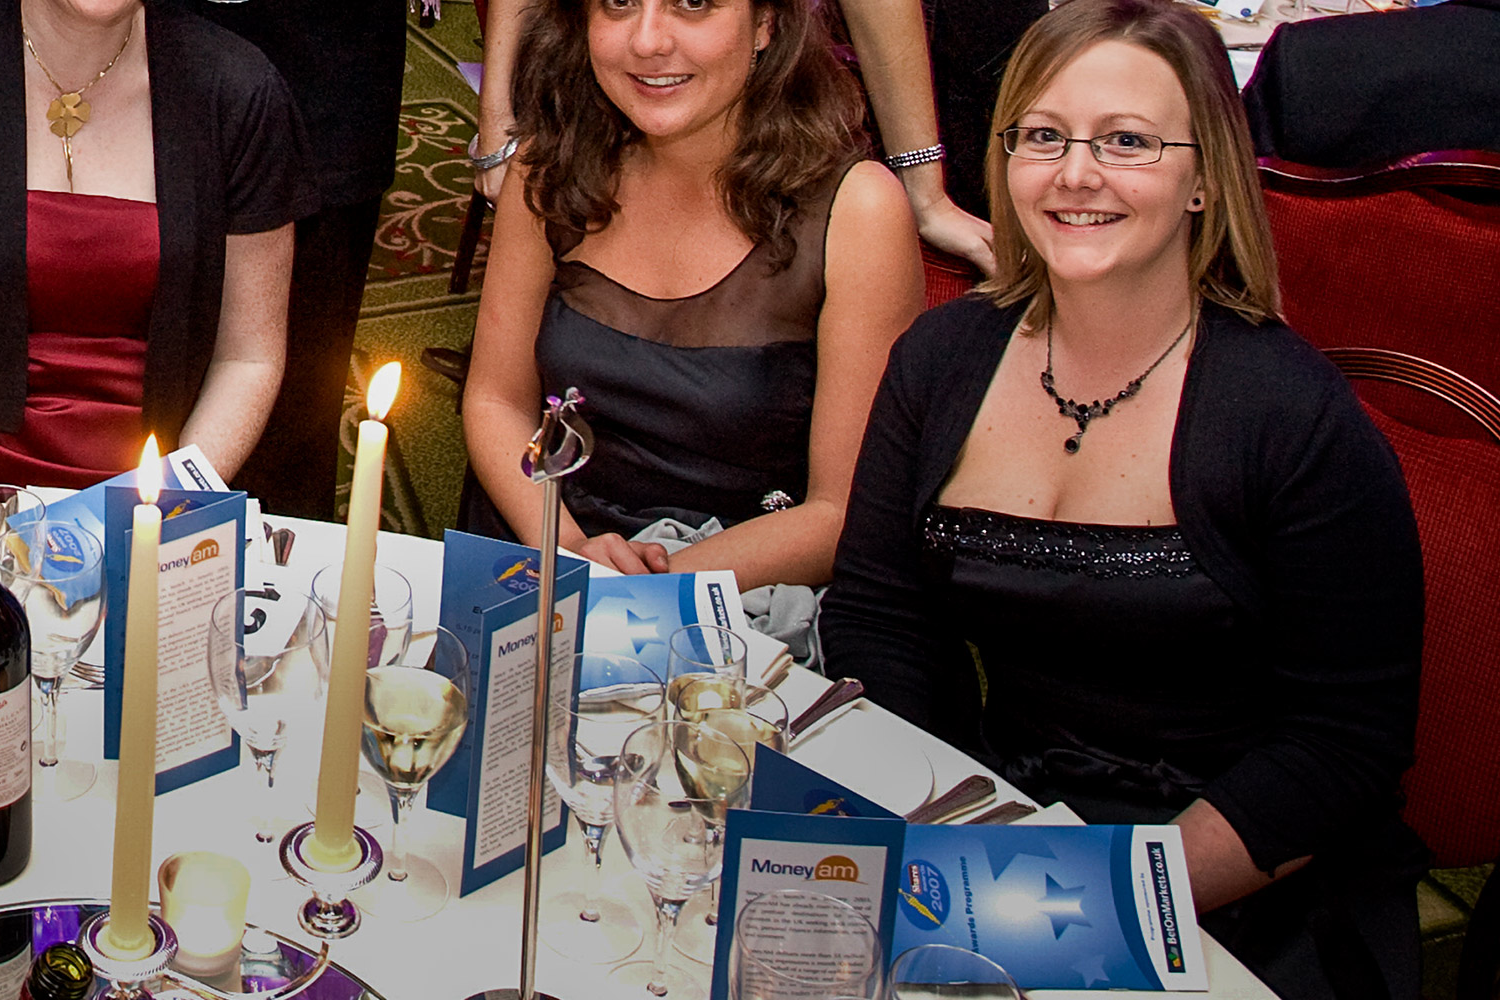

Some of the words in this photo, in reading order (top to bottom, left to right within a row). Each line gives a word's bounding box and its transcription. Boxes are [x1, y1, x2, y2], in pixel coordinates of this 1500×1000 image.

[158, 556, 190, 575] oney
[192, 543, 218, 562] am
[508, 578, 539, 591] 200
[498, 632, 537, 658] Money
[751, 858, 814, 879] Money
[818, 864, 855, 879] am
[926, 866, 943, 912] 2007
[959, 855, 974, 916] Programme
[1150, 847, 1178, 945] BetOnMarkets.co.uk
